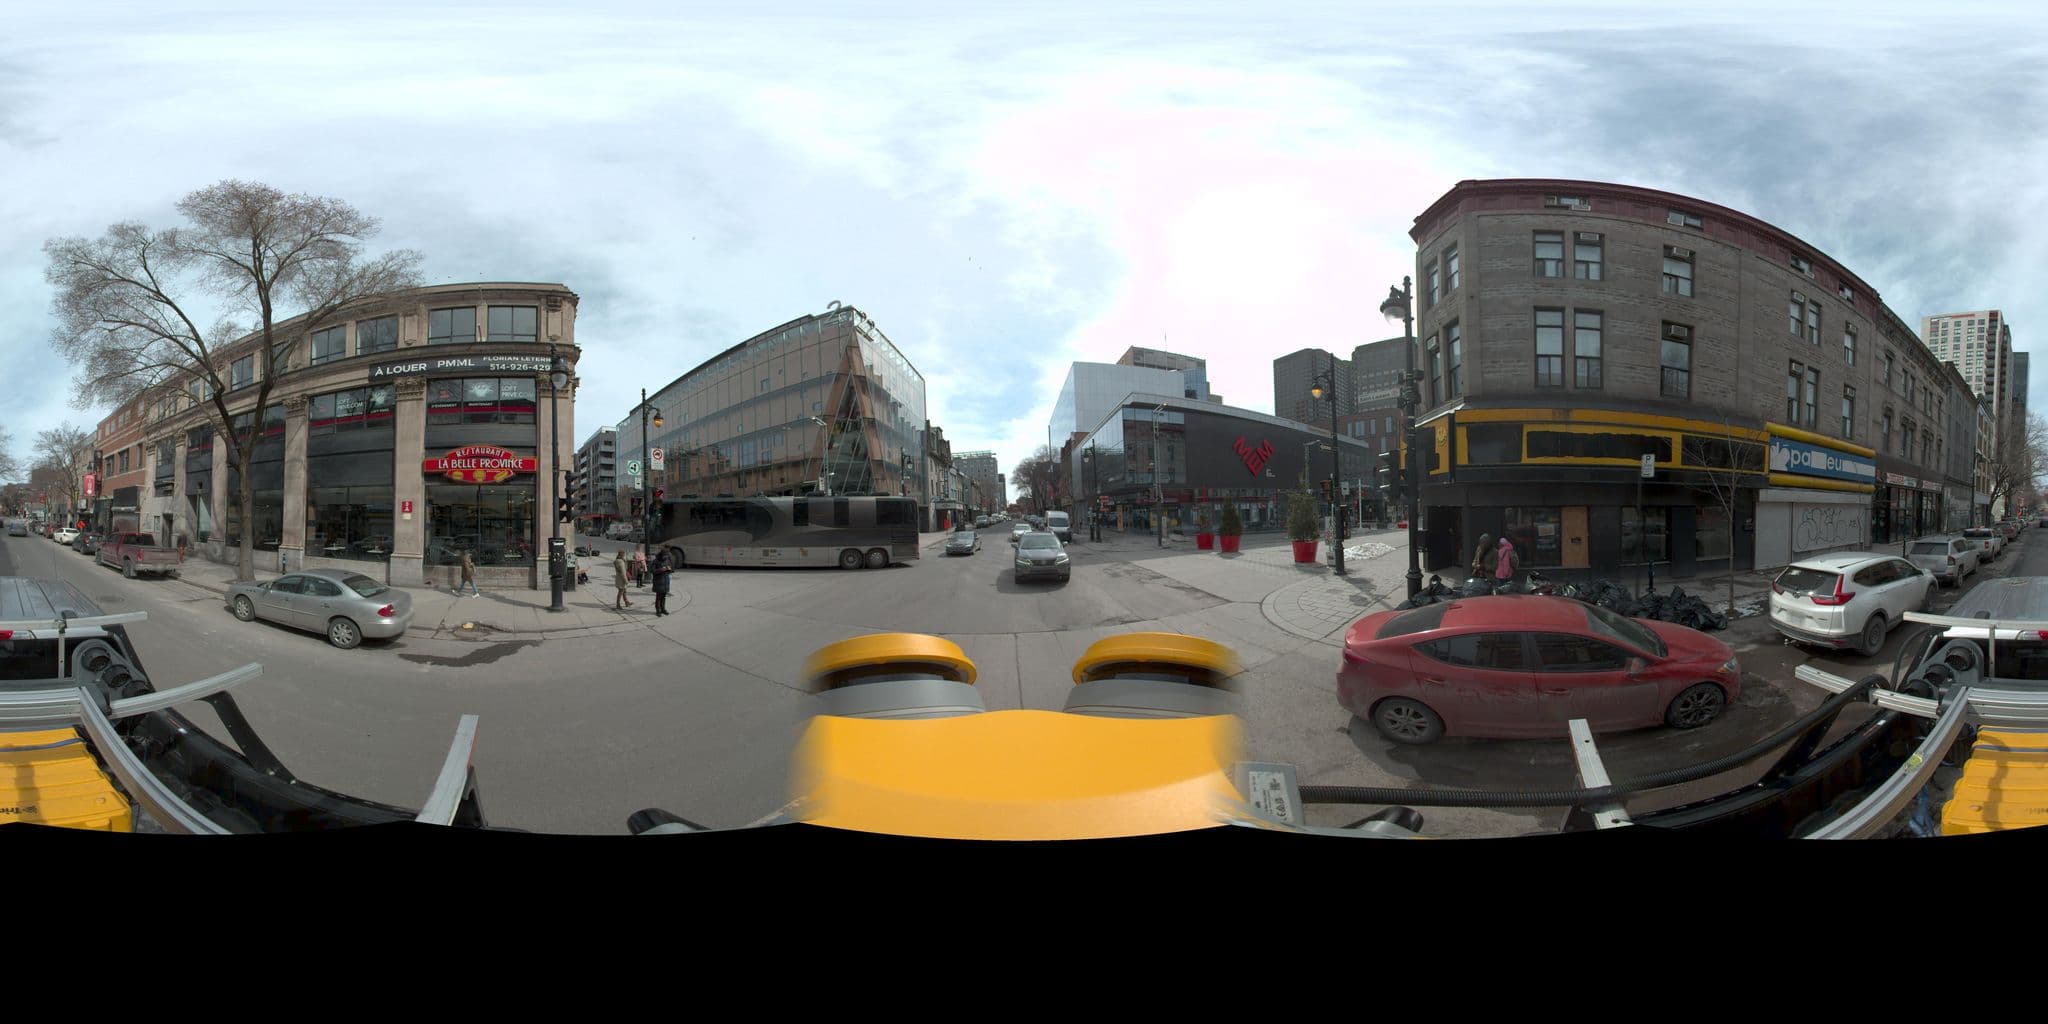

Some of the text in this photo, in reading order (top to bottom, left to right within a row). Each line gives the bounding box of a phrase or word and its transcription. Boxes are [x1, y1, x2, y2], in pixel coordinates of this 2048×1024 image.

[437, 359, 475, 368] PMML
[489, 363, 552, 371] 514-926-429
[374, 363, 427, 377] À LOUER
[456, 447, 505, 458] RESTAURANT
[438, 459, 523, 469] LA BELLE PROVINCE
